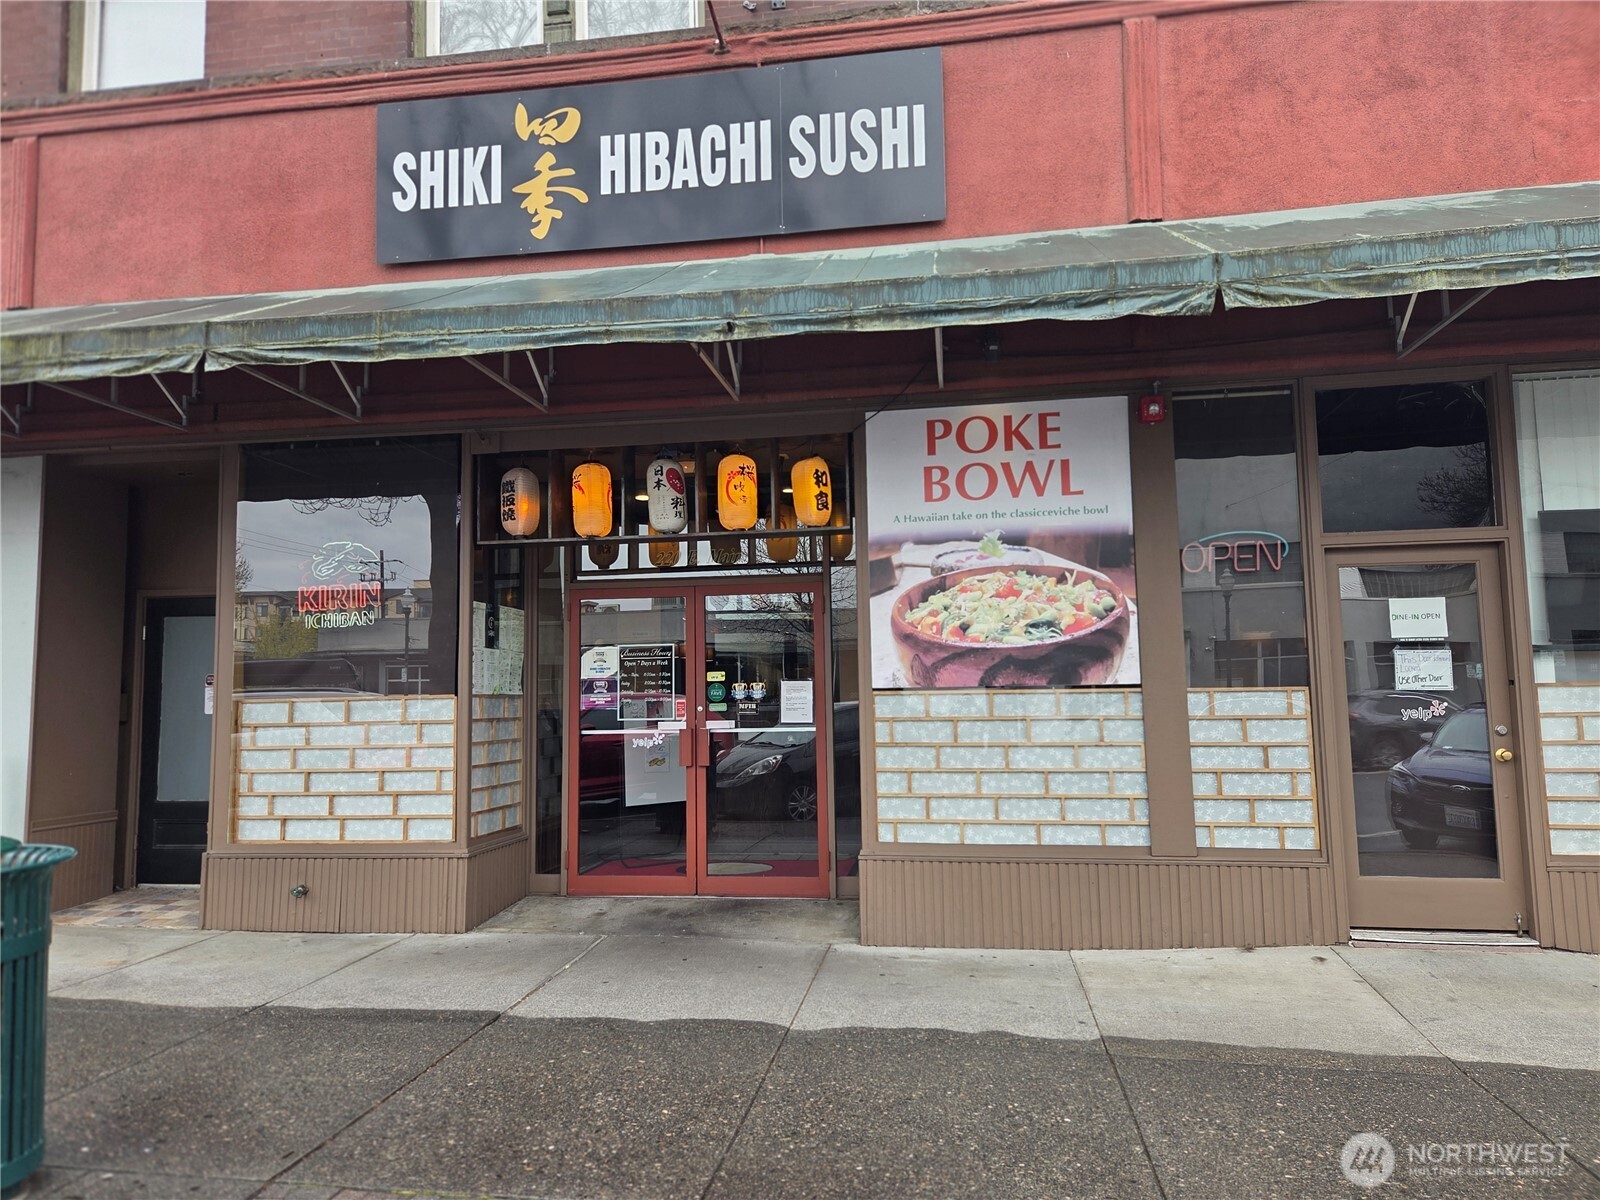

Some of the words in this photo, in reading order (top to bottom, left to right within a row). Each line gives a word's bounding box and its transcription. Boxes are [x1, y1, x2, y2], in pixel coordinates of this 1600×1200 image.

[392, 144, 502, 212] SHIKI
[600, 119, 772, 195] HIBACHI
[788, 103, 927, 179] SUSHI
[512, 102, 589, 240] 四季
[926, 412, 1062, 456] POKE
[653, 465, 667, 491] 日本
[813, 469, 829, 511] 和食
[923, 458, 1084, 503] BOWL
[671, 496, 686, 519] 料理
[893, 515, 901, 523] A
[904, 512, 949, 523] Hawaiian
[952, 511, 973, 521] take
[975, 512, 988, 520] on
[991, 509, 1007, 519] the
[1010, 505, 1080, 518] classicceviche
[1083, 504, 1109, 515] bowl
[1181, 540, 1282, 573] OPEN
[298, 581, 381, 612] KIRIN
[305, 611, 375, 629] ICHIBAN
[1391, 613, 1420, 621] DINE-IN
[1420, 612, 1441, 620] OPEN
[1400, 706, 1433, 721] yelp
[632, 737, 653, 749] yelp
